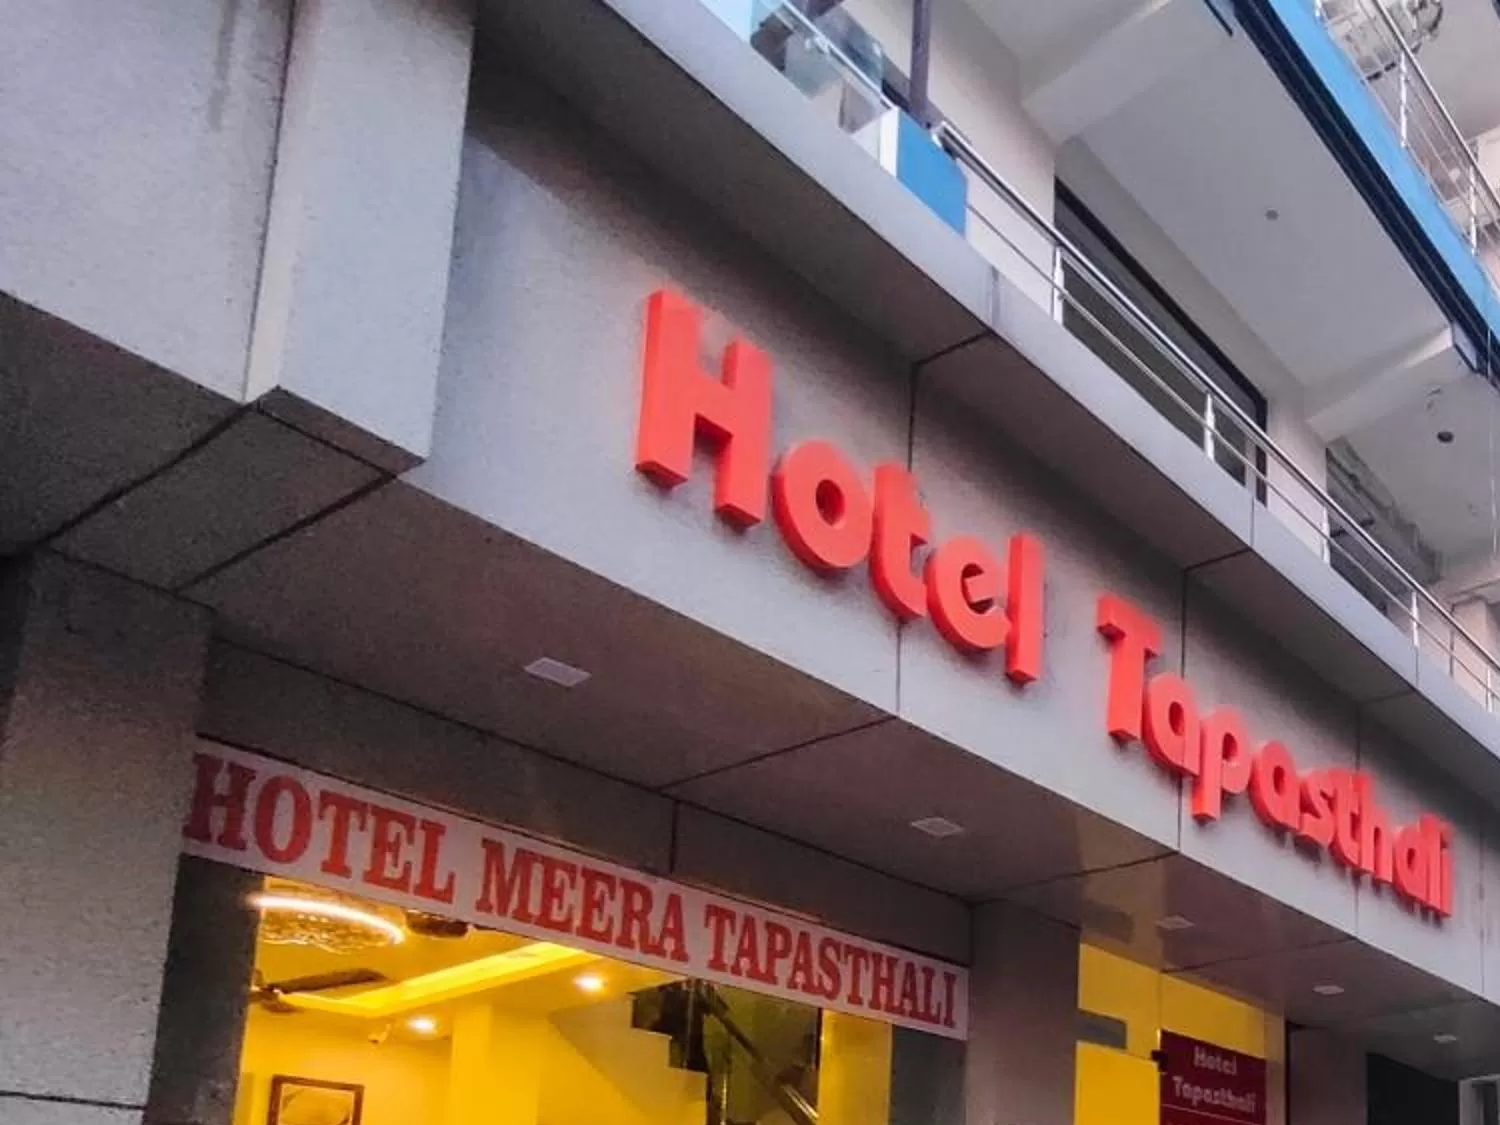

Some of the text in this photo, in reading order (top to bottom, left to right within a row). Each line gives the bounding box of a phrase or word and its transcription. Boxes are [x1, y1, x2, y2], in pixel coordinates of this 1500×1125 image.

[635, 289, 1453, 918] Hotel Tapasthali
[181, 751, 958, 1029] HOTEL MEERA TAPASTHALI
[1193, 1044, 1237, 1076] Hotel
